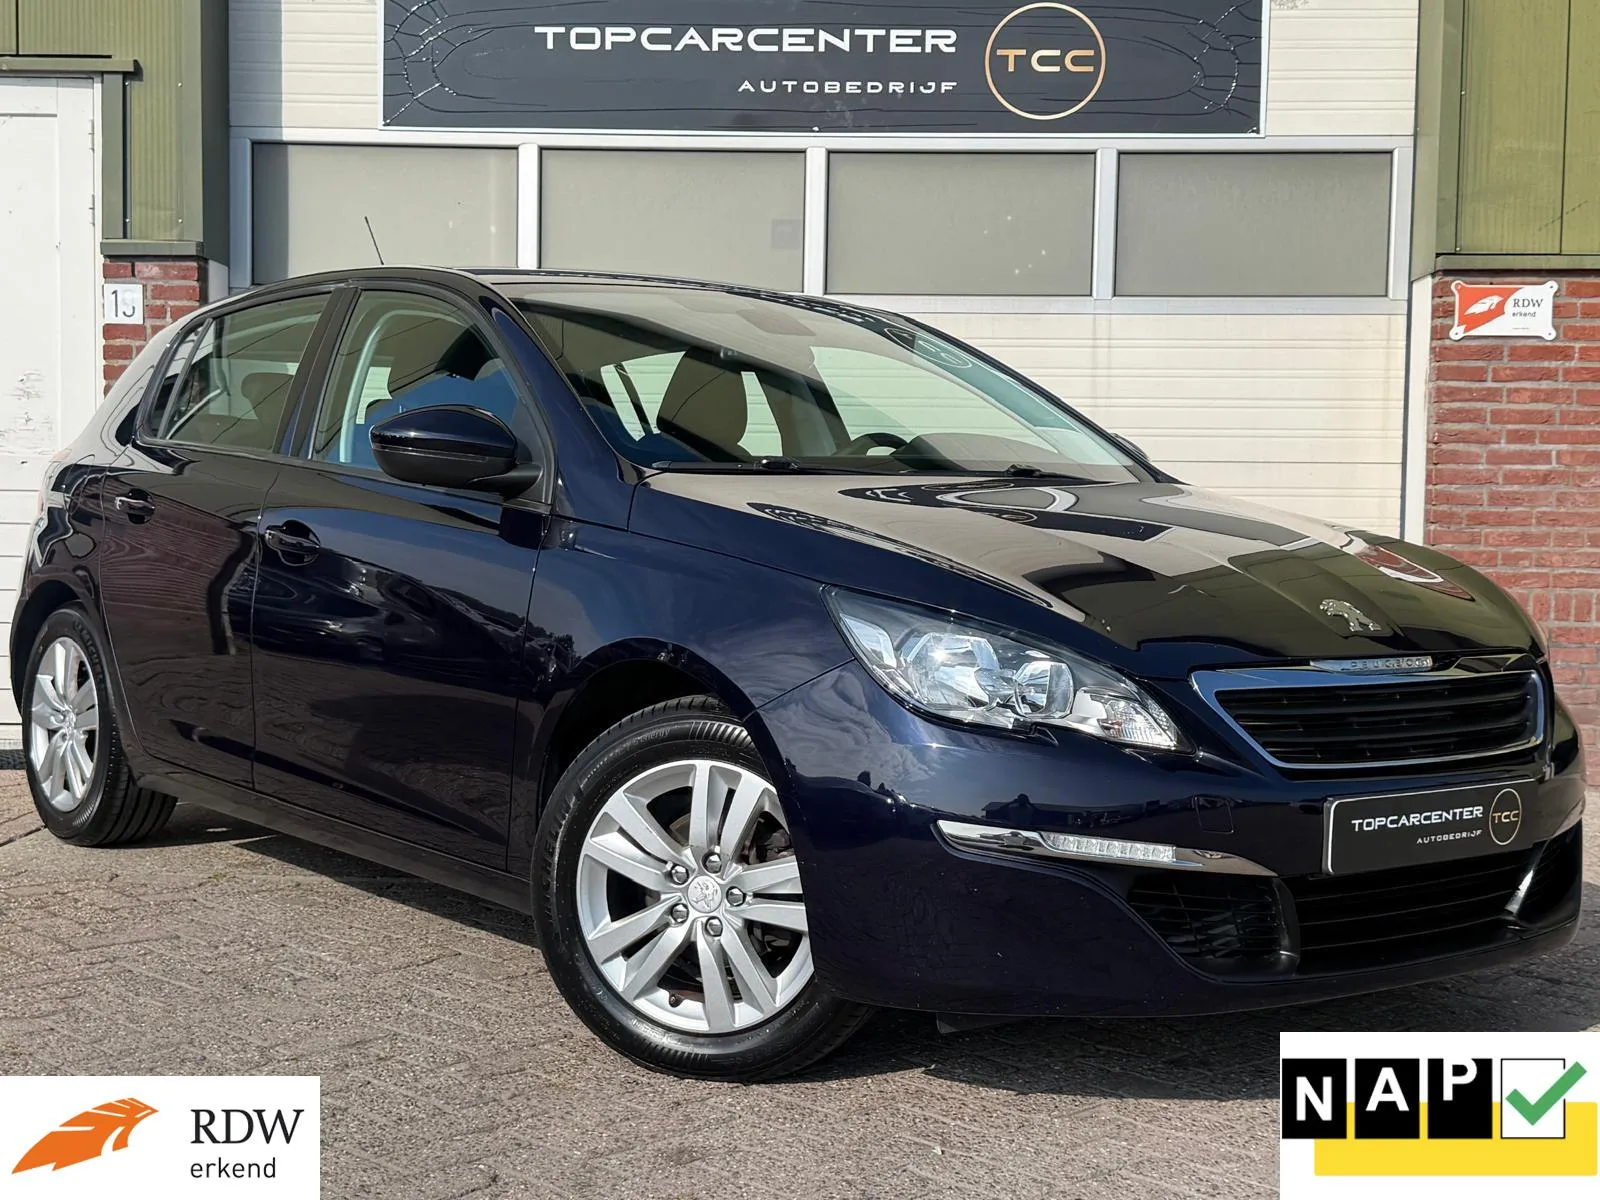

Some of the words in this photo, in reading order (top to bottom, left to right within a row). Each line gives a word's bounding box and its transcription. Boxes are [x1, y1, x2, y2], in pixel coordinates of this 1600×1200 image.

[534, 26, 957, 53] TOPCARCENTER
[996, 48, 1095, 72] TCC
[738, 80, 958, 94] AUTOBEDRIJF
[1512, 298, 1543, 308] RDW
[1351, 806, 1484, 832] TOPCARCENTER
[1492, 810, 1519, 824] TCC
[1416, 829, 1482, 844] AUTOBEDRIJF
